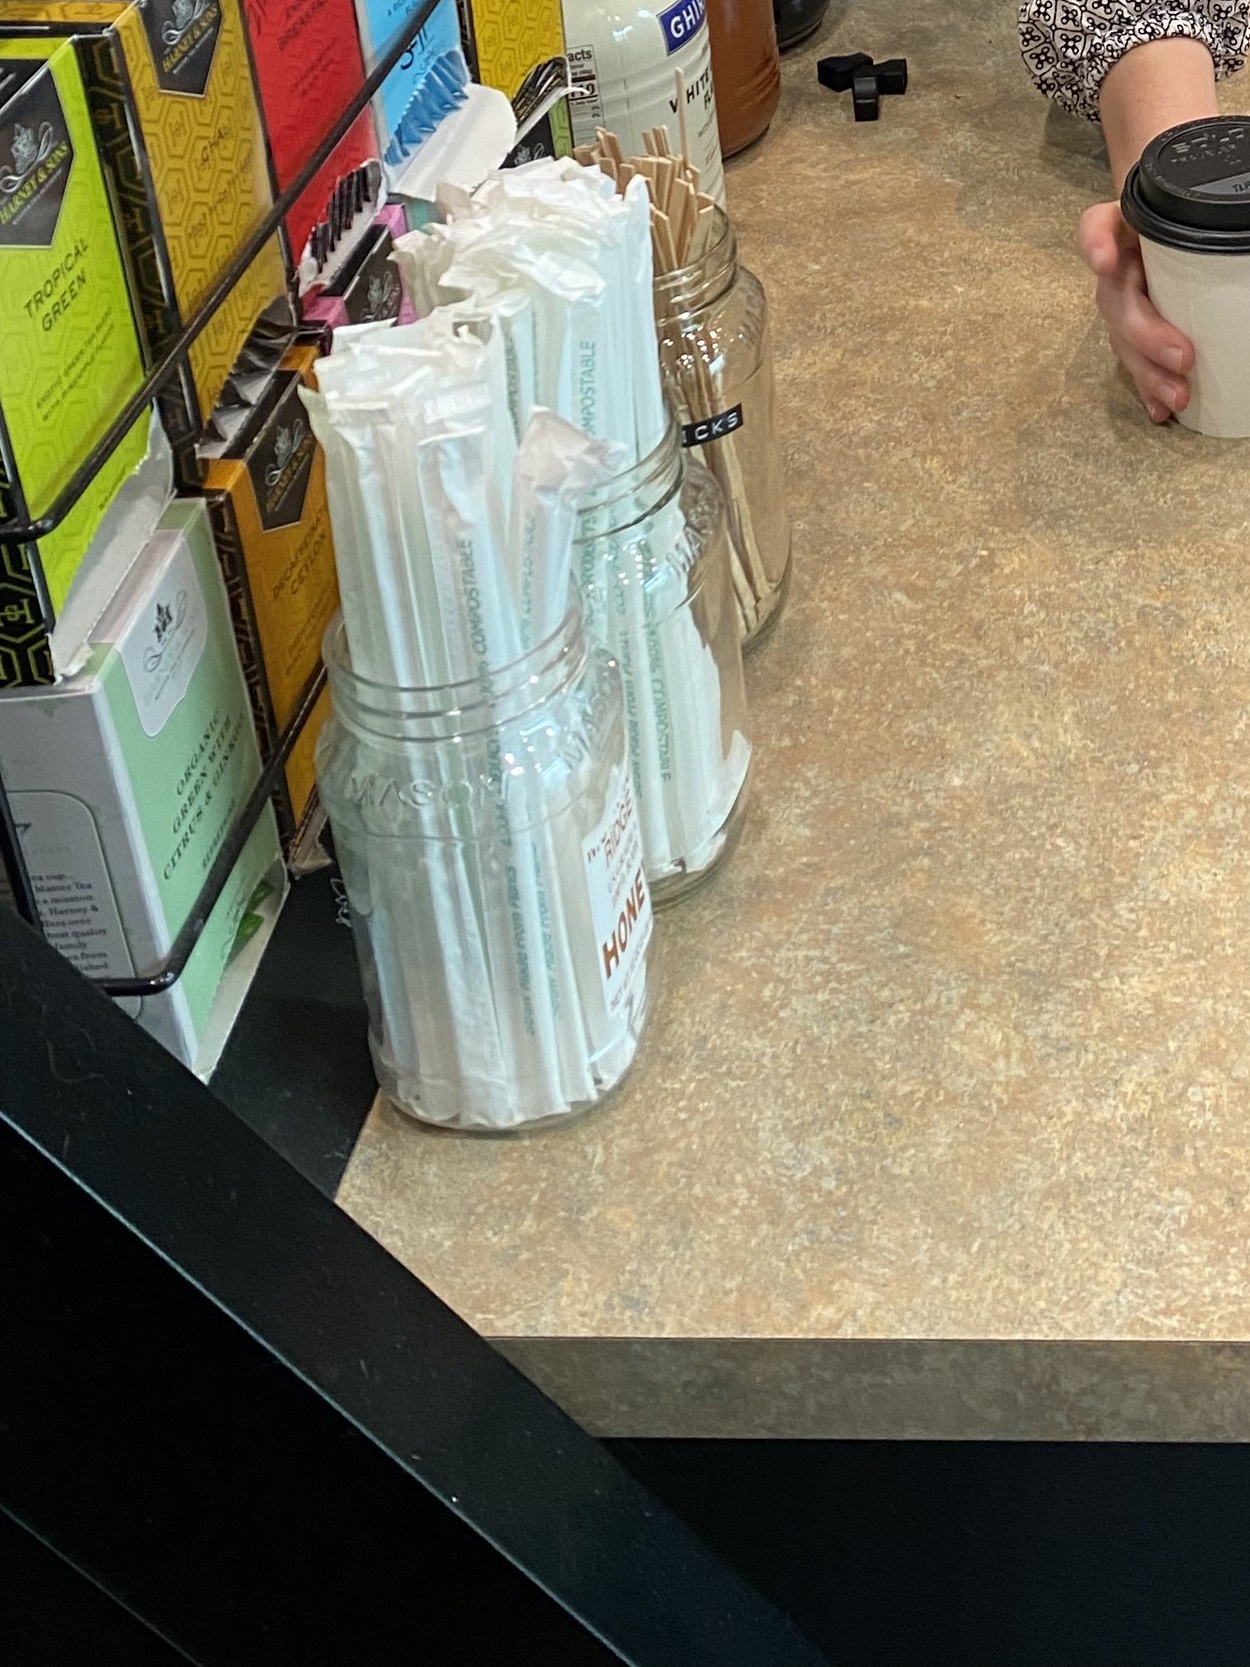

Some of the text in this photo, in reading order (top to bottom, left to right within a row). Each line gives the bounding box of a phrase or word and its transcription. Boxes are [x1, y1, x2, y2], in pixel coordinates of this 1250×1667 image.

[22, 237, 89, 320] TROPICAL
[41, 274, 88, 333] GREEN
[456, 537, 488, 657] COMPOSTABLE
[175, 709, 222, 798] ORGANIC
[163, 805, 205, 882] CITRUS
[172, 774, 208, 836] GREEN
[48, 906, 88, 918] Harney
